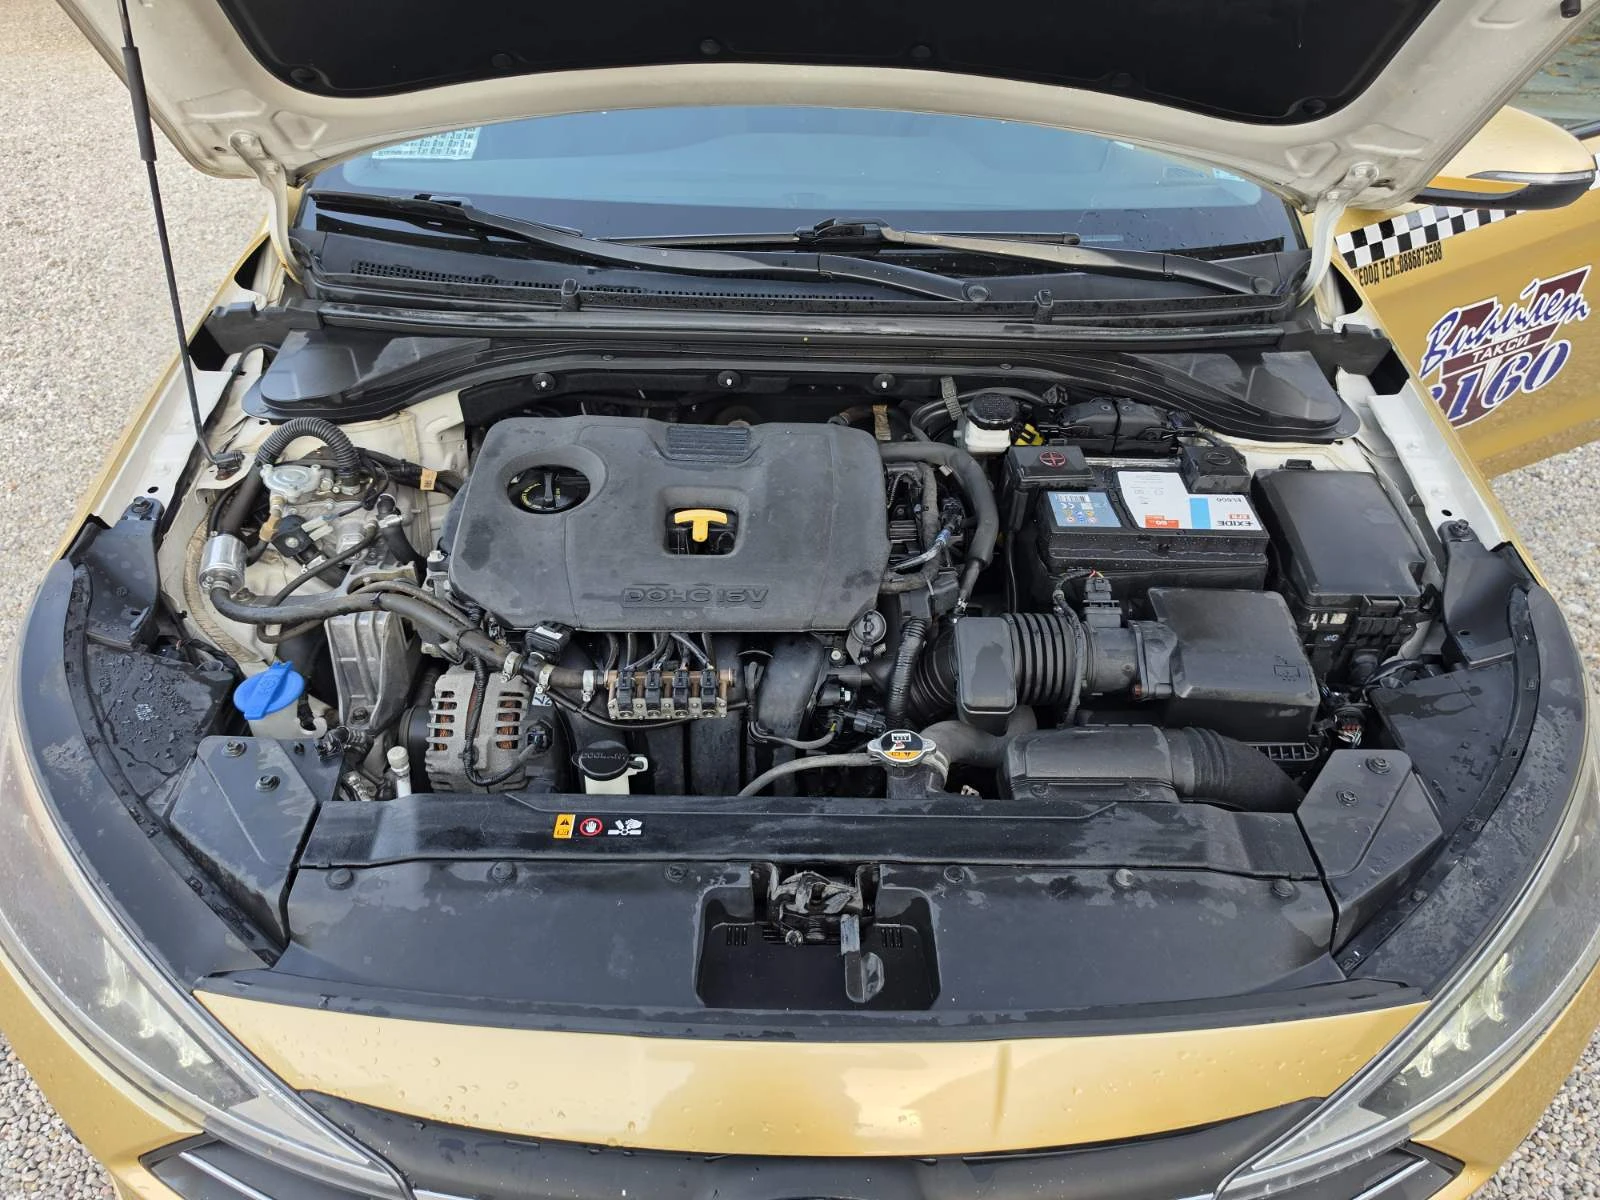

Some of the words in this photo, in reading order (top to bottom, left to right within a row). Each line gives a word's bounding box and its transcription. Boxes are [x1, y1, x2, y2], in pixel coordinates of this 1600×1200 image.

[1472, 333, 1531, 363] ТАКСИ
[1430, 340, 1571, 420] 160
[1217, 519, 1253, 528] EXIDE
[623, 587, 712, 603] DOHC
[717, 587, 769, 604] 16V
